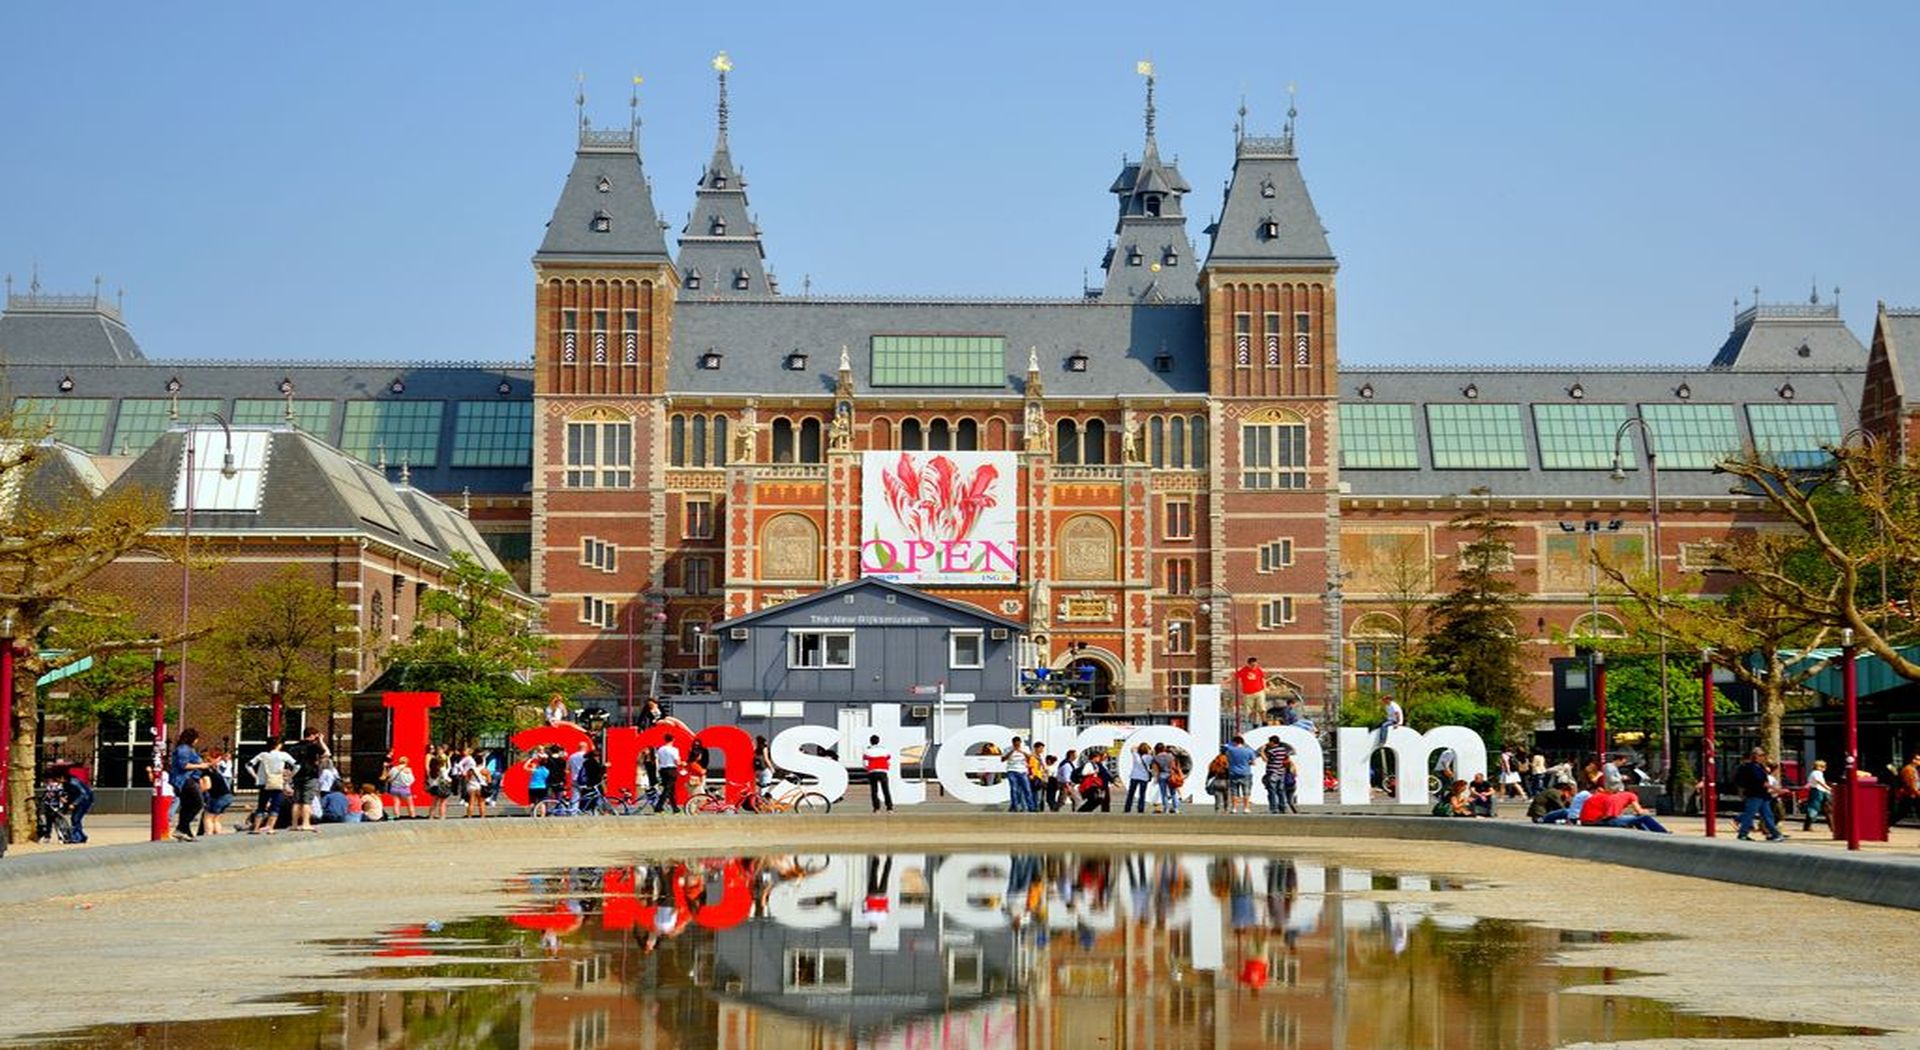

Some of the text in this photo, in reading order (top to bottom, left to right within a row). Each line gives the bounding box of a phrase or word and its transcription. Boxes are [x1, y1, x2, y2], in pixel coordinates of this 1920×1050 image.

[861, 539, 1017, 573] OPEN
[810, 615, 930, 625] The New Rijksmuseum
[382, 691, 442, 808] I
